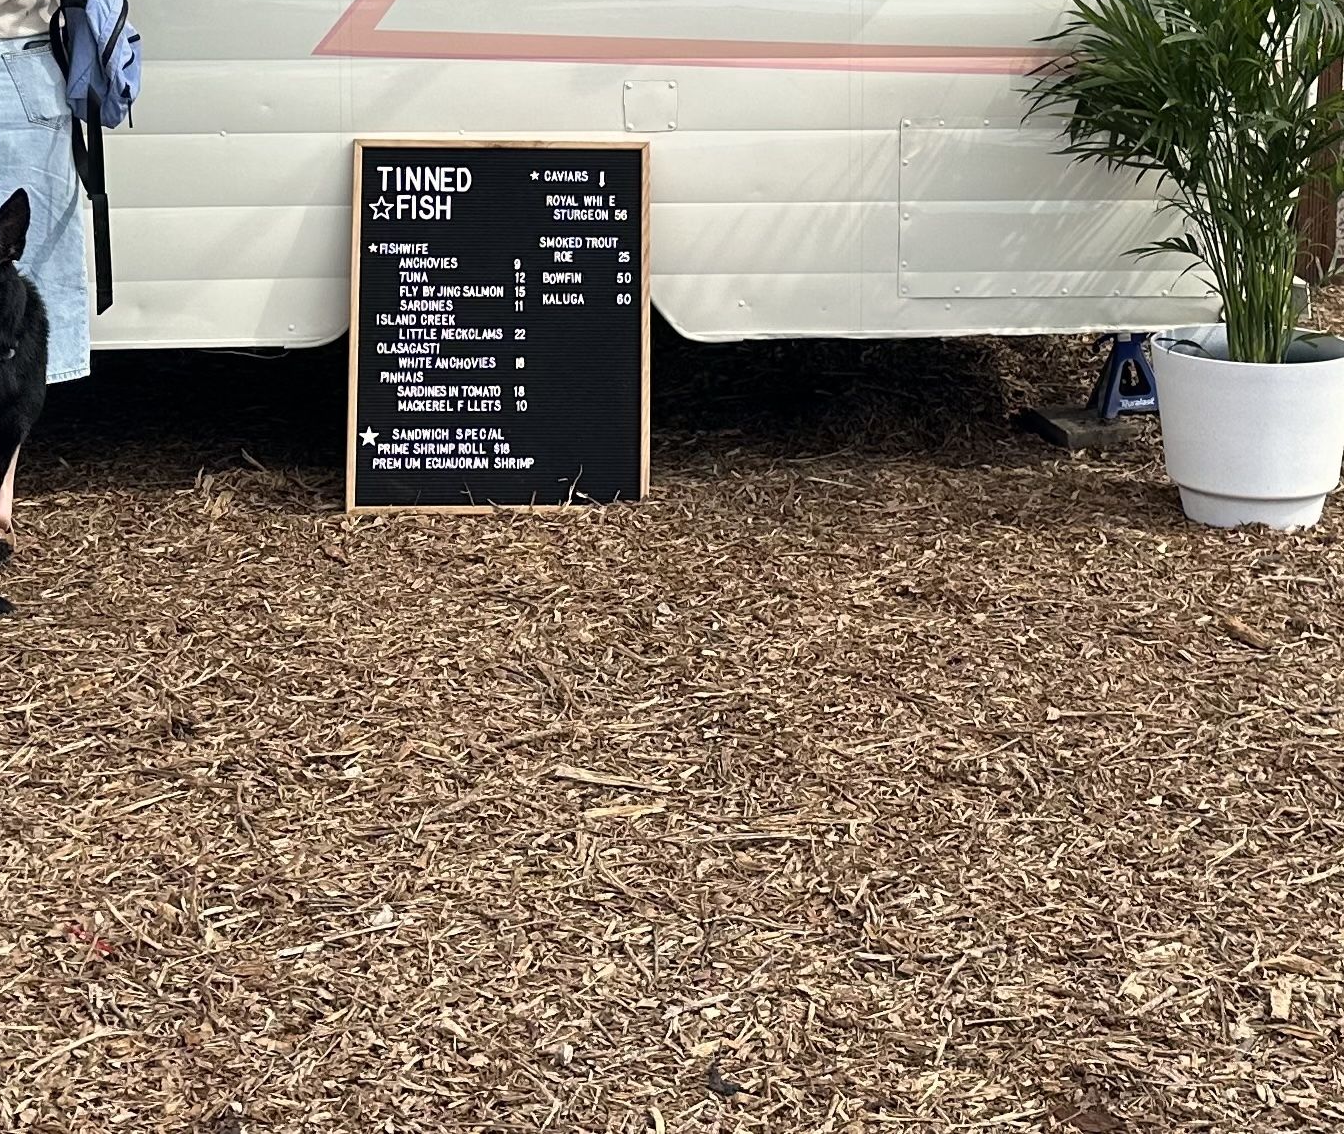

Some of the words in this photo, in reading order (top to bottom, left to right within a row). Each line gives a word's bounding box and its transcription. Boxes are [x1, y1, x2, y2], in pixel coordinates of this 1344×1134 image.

[377, 167, 471, 192] TINNED
[544, 171, 588, 181] CAVIARS
[546, 195, 578, 206] ROYAL
[397, 195, 451, 219] FISH
[553, 209, 608, 220] STURGEON
[539, 237, 582, 248] SMOKED
[585, 237, 618, 248] TROUT
[380, 243, 428, 254] FISHWIFE
[554, 251, 573, 262] ROE
[619, 252, 630, 262] 25
[399, 257, 458, 269] ANCHOVIES
[514, 259, 521, 269] 9
[400, 272, 428, 282] TUNA
[515, 272, 525, 283] 12
[543, 272, 581, 284] BOWFIN
[617, 272, 631, 283] 50
[400, 286, 418, 297] FLY
[423, 286, 435, 297] BY
[437, 286, 461, 297] JING
[463, 286, 503, 297] SALMON
[515, 286, 525, 297] 15
[543, 293, 584, 304] KALUGA
[617, 294, 631, 304] 60
[400, 300, 453, 311] SARDINES
[515, 300, 523, 311] 11
[377, 314, 416, 325] ISLAND
[421, 314, 455, 325] CREEK
[399, 328, 437, 339] LITTLE
[515, 329, 525, 339] 22
[399, 357, 432, 368] WHITE
[435, 357, 496, 369] ANCHOVIES
[380, 371, 423, 383] PINHAIS
[397, 386, 447, 397] SARDINES
[449, 386, 458, 397] IN
[461, 386, 501, 397] TOMATO
[398, 400, 453, 411] MACKEREL
[516, 400, 527, 411] 10
[392, 428, 449, 440] SANDWICH
[378, 443, 409, 454] PRIME
[413, 443, 455, 454] SHRIMP
[458, 443, 486, 454] ROLL
[494, 457, 534, 469] SHRIMP
